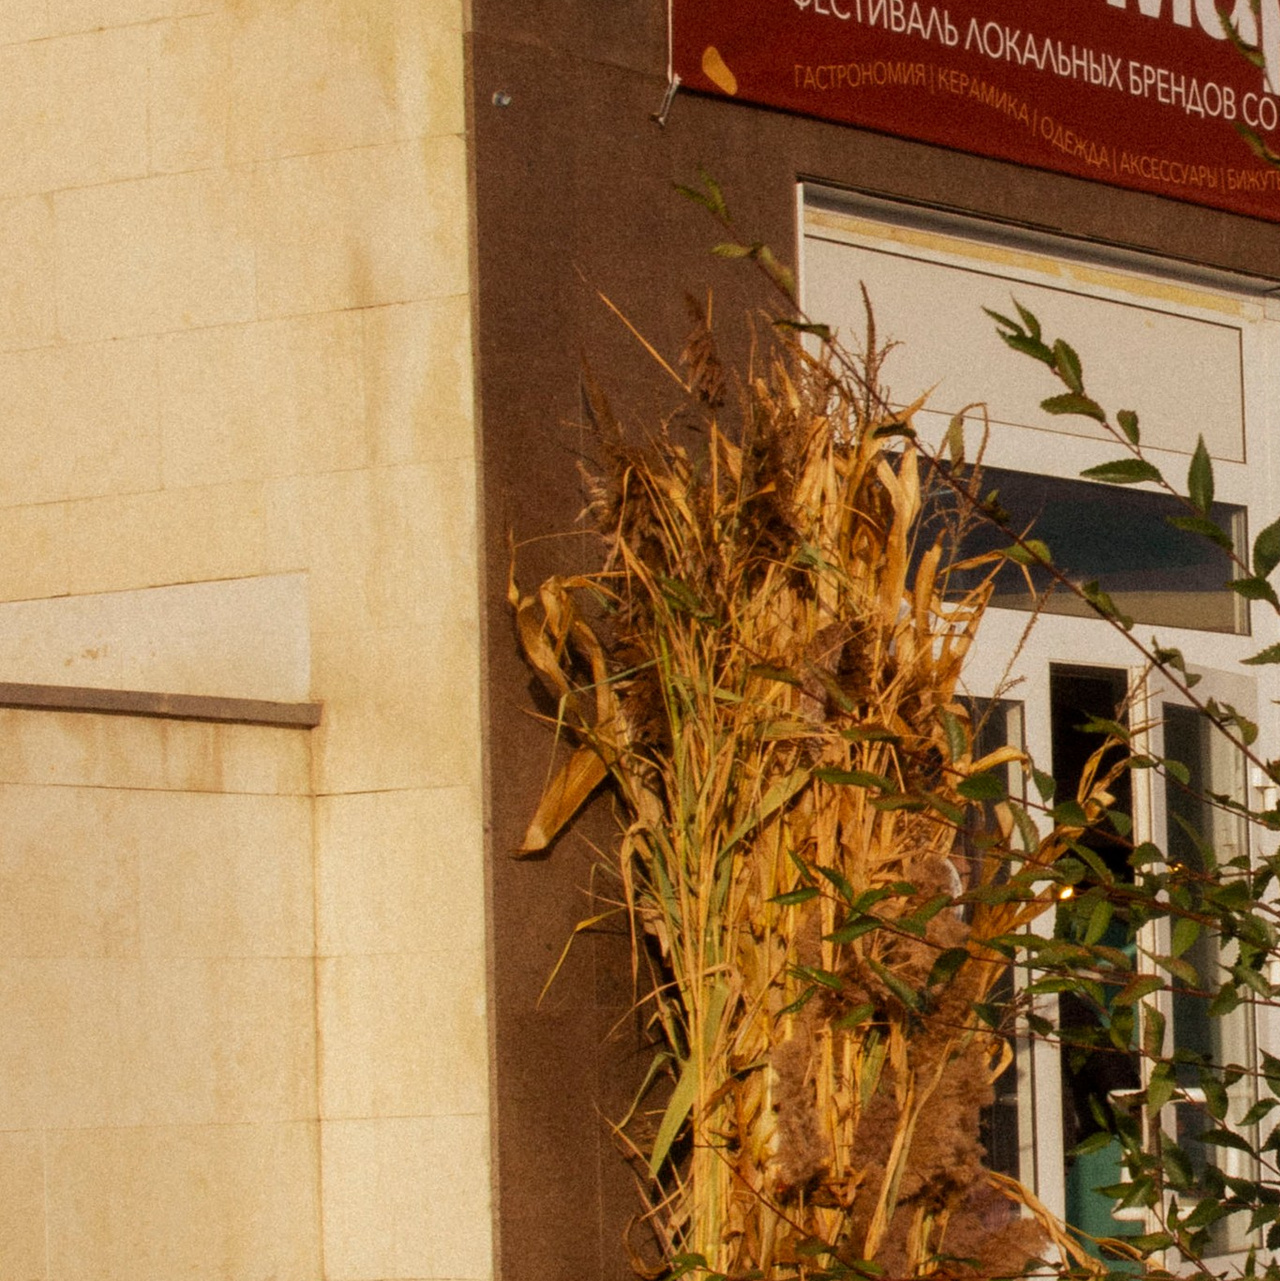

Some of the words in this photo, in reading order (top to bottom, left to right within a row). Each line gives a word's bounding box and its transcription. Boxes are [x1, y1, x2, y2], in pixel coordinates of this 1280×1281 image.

[794, 61, 926, 91] ГАСТРОНОМИЯ
[938, 67, 1029, 127] КЕРАМИКА
[1041, 117, 1110, 167] ОДЕЖДА
[1120, 152, 1218, 188] АКСЕССУАРЫ
[965, 18, 1123, 92] ЛОКАЛЬНЫХ
[1129, 61, 1236, 120] БРЕНДОВ
[1242, 92, 1278, 130] СО
